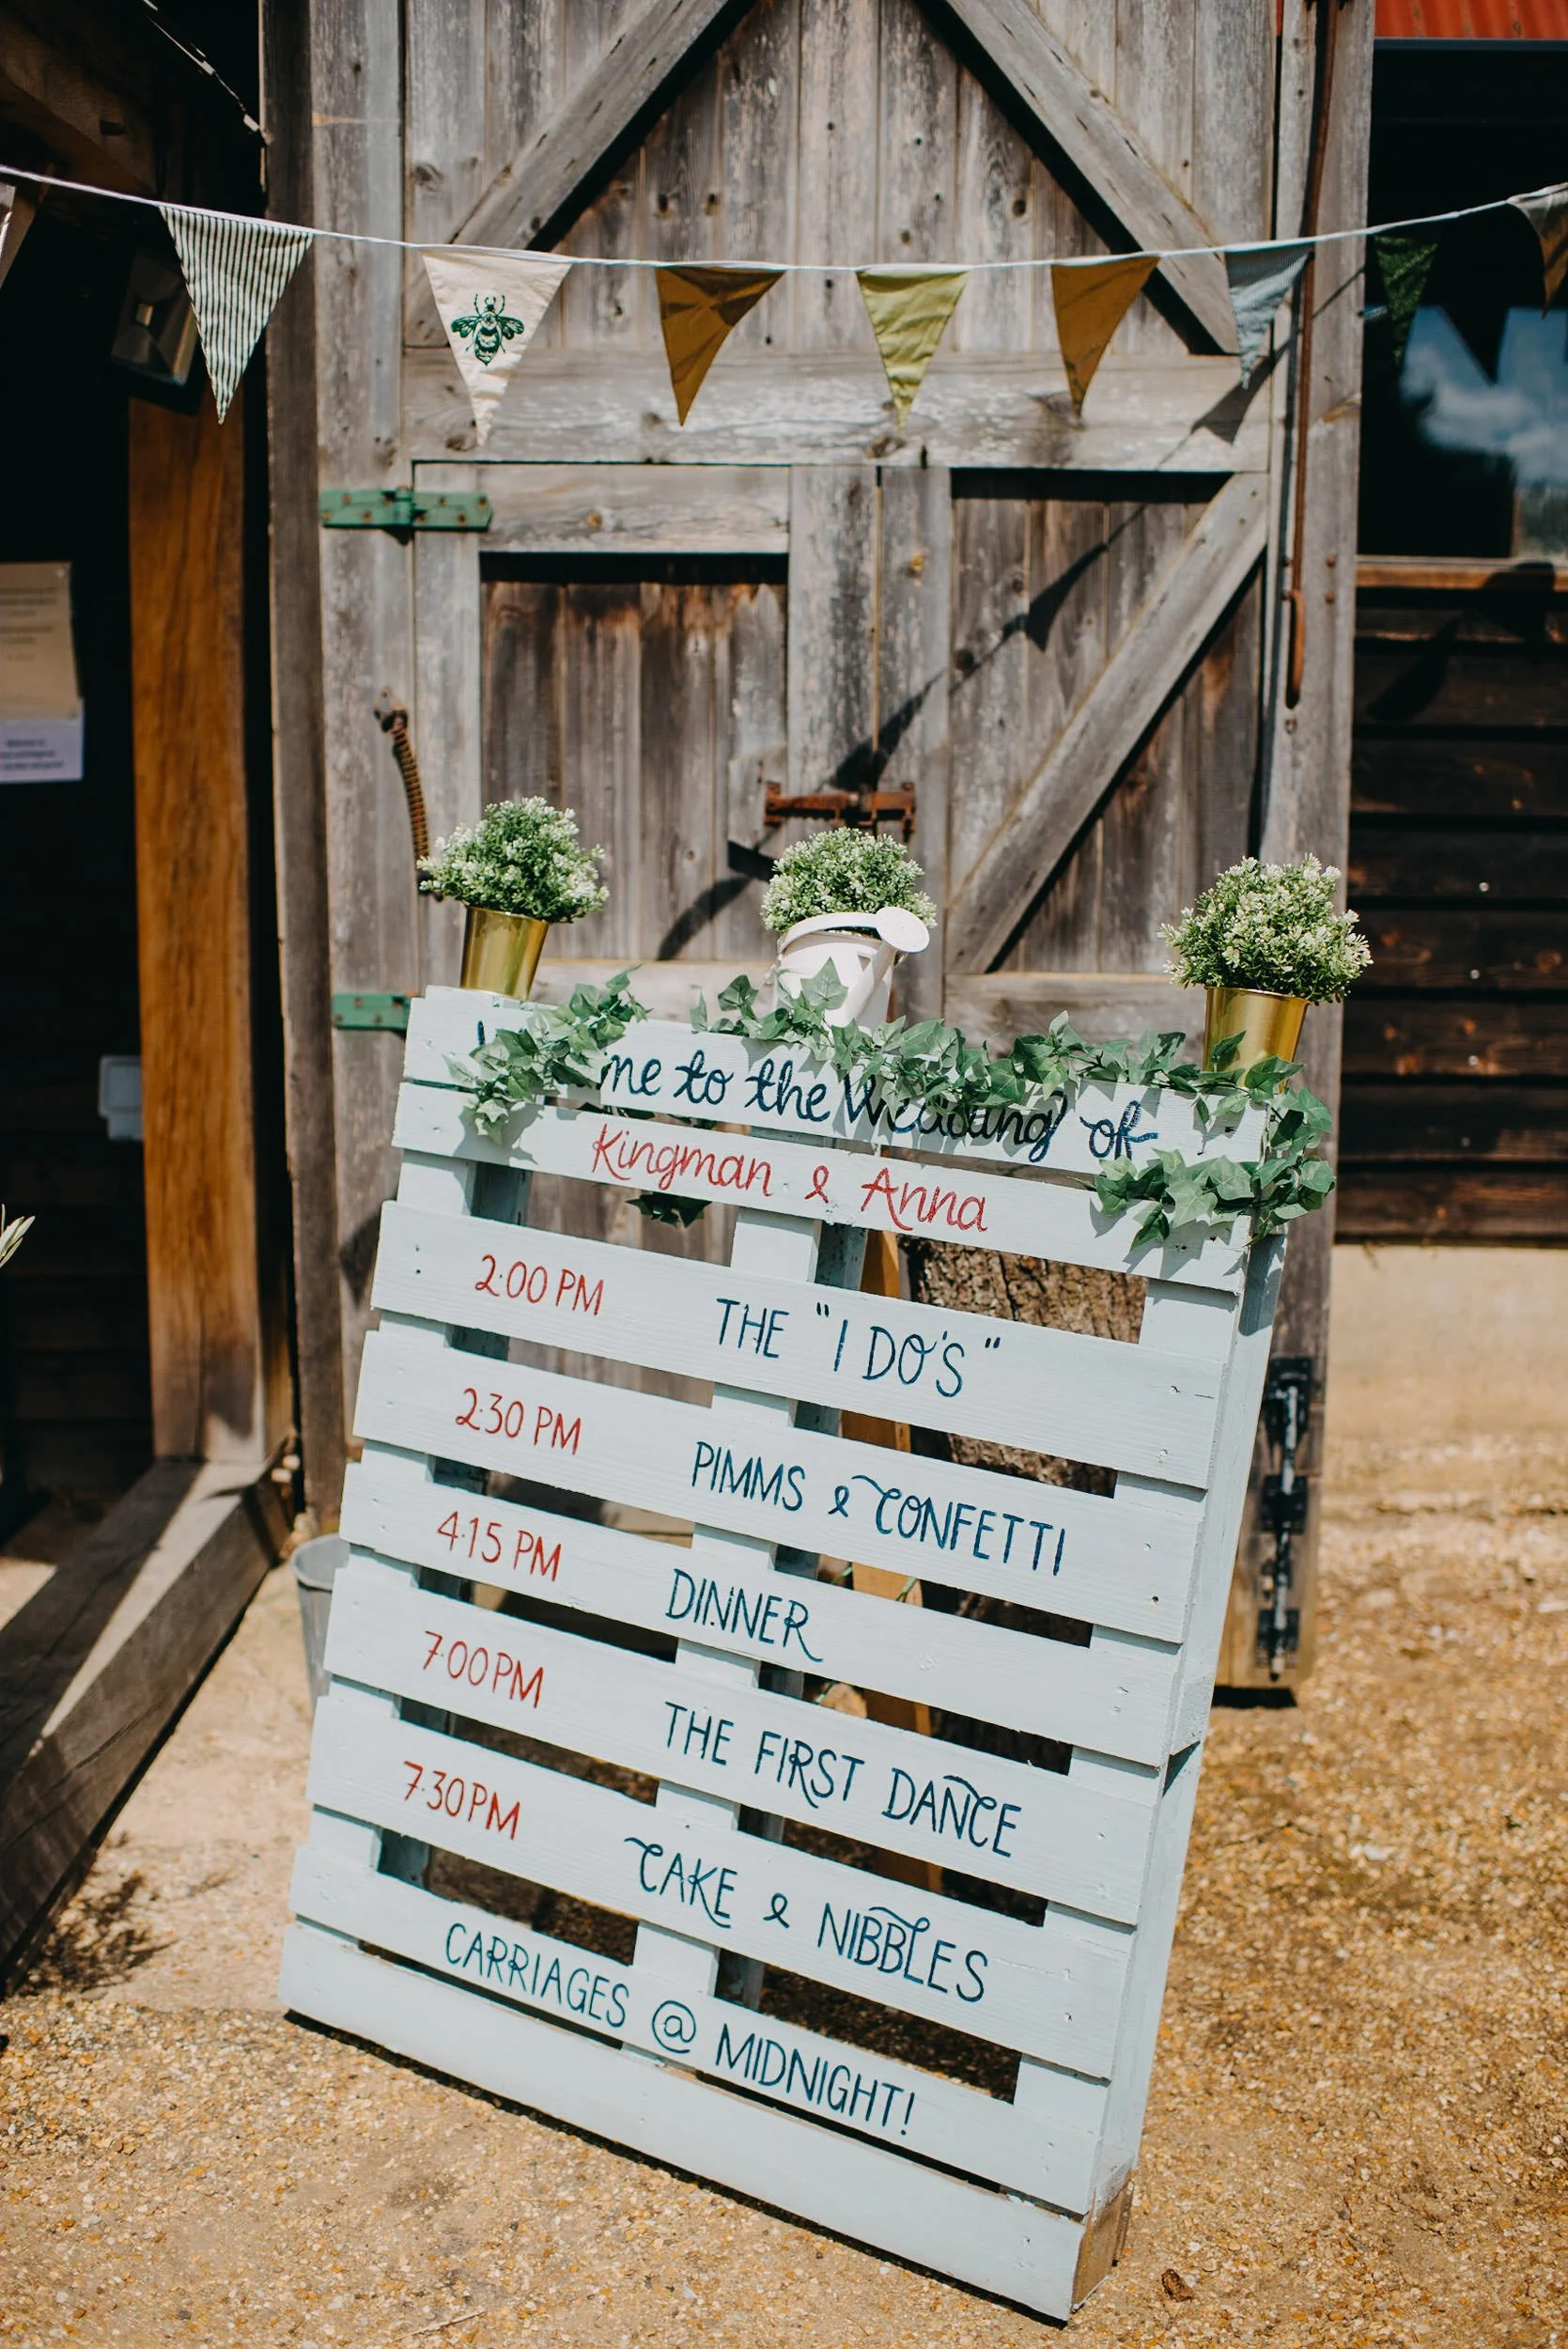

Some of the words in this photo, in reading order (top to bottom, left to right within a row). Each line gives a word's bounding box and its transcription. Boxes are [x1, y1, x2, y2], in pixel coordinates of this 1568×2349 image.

[673, 1050, 734, 1104] to
[744, 1058, 831, 1122] the
[1079, 1100, 1159, 1160] of
[592, 1123, 774, 1197] Kingman
[804, 1165, 830, 1204] &
[861, 1167, 989, 1232] Anna
[555, 1268, 604, 1315] PM
[716, 1298, 789, 1359] THE
[534, 1406, 582, 1455] PM
[691, 1440, 805, 1512] PIMMS
[828, 1486, 850, 1517] &
[851, 1474, 1065, 1577] CONFETTI
[514, 1530, 562, 1581] PM
[665, 1568, 824, 1662] DINNER
[664, 1701, 734, 1766] THE
[753, 1730, 865, 1809] FIRST
[881, 1767, 1022, 1858] DANCE
[624, 1837, 737, 1928] CAKE
[763, 1892, 790, 1928] &
[817, 1903, 988, 2003] NIBBLES
[445, 1923, 629, 2028] CARRIAGES
[651, 2000, 696, 2053] @
[715, 2023, 916, 2136] MIDNIGHT!
